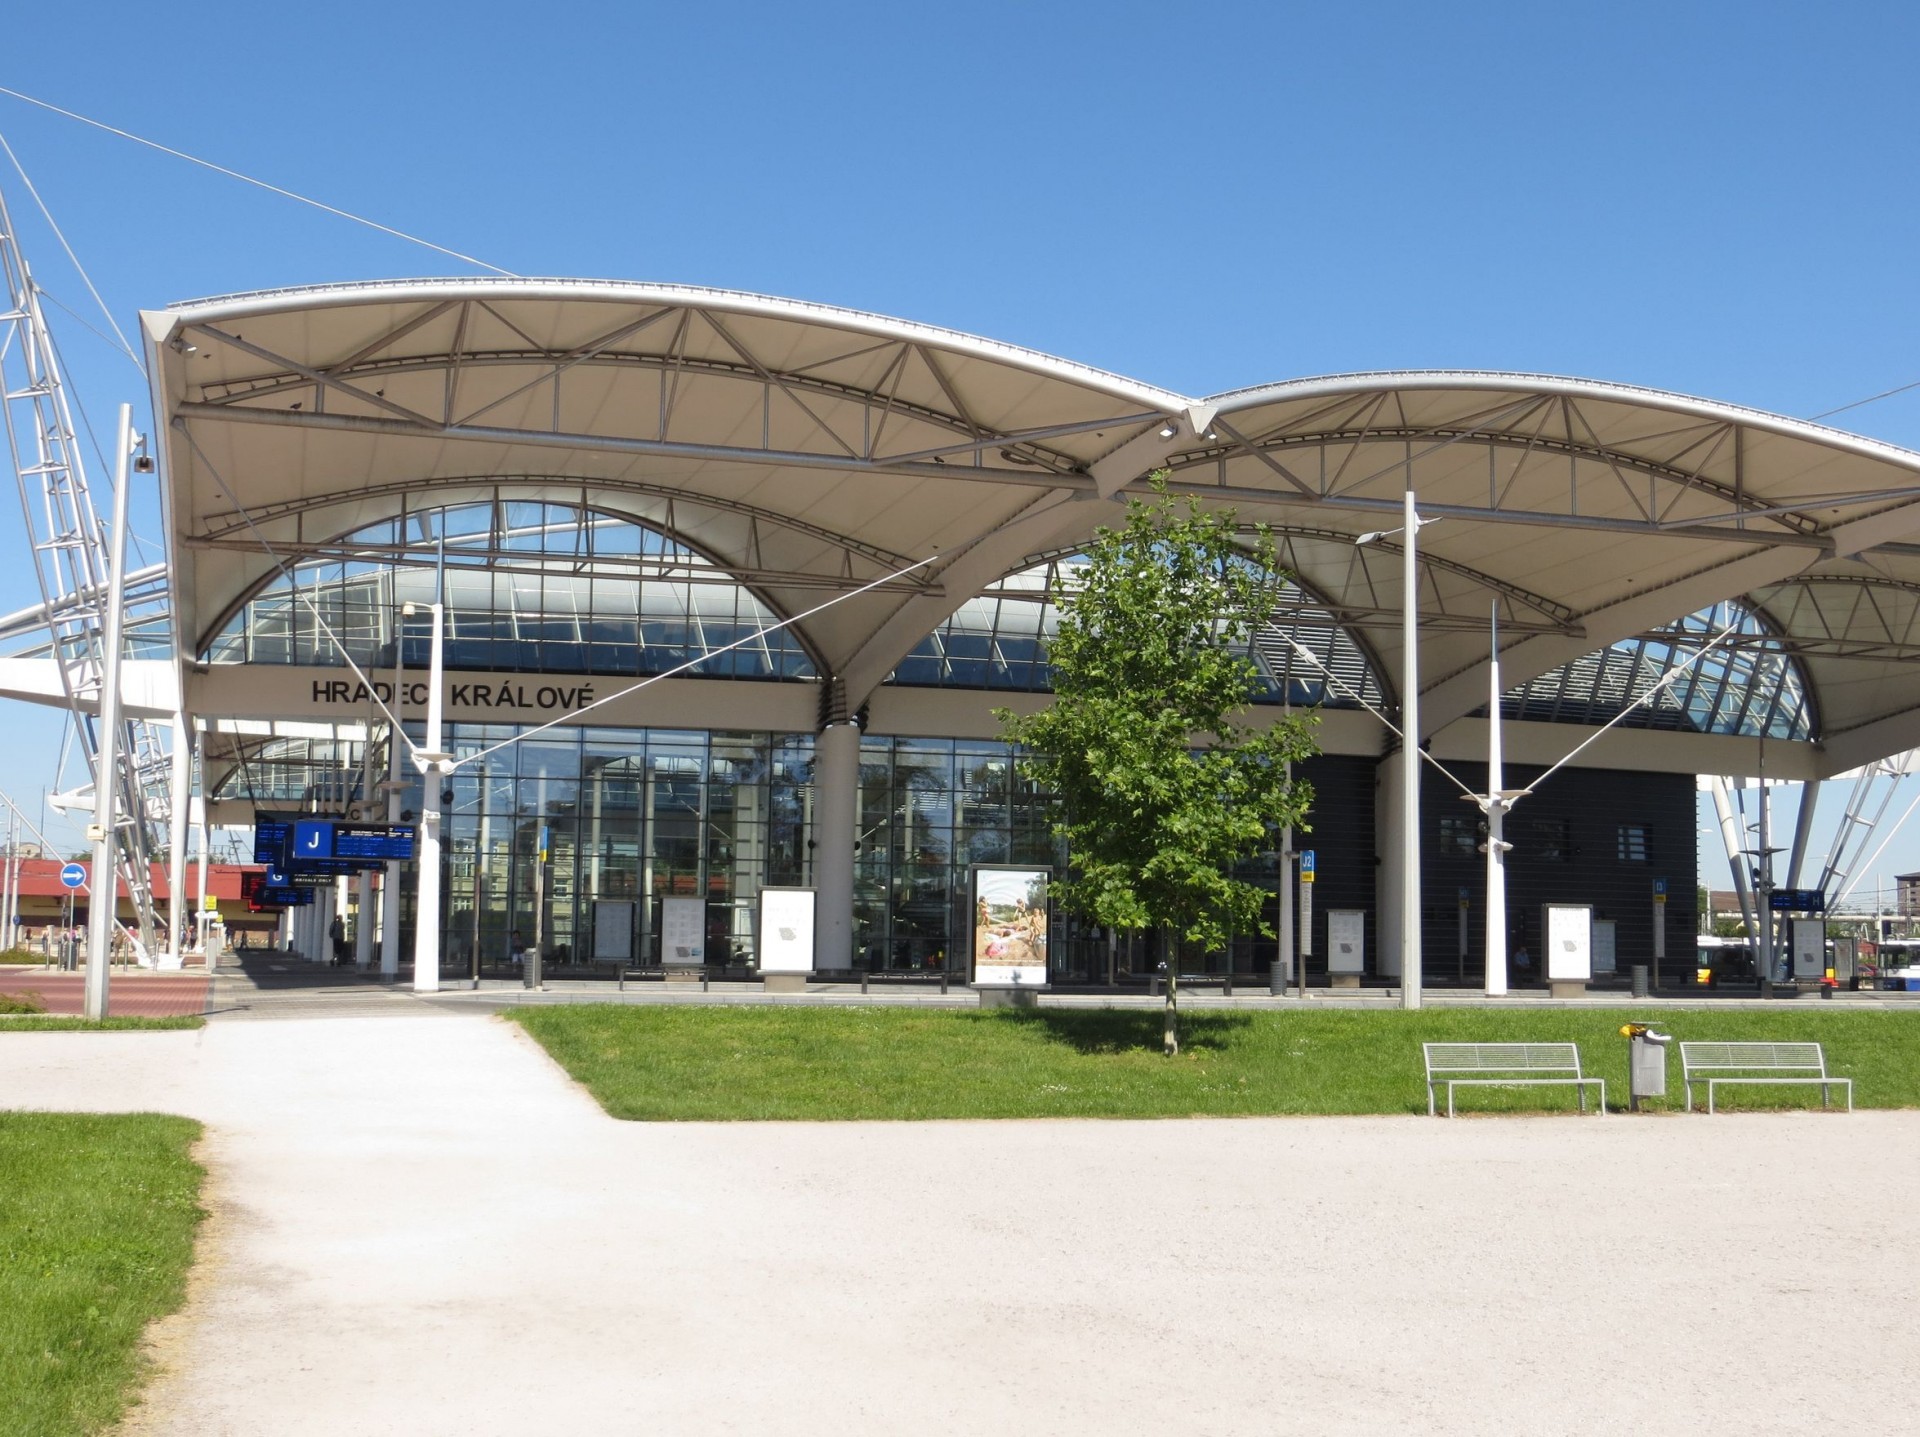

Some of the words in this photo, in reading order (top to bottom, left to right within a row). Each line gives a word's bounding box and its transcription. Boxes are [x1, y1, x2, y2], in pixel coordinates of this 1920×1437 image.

[312, 680, 429, 705] HRADEC
[451, 680, 595, 709] KRÁLOVÉ
[308, 831, 320, 849] J
[1303, 855, 1312, 868] J2
